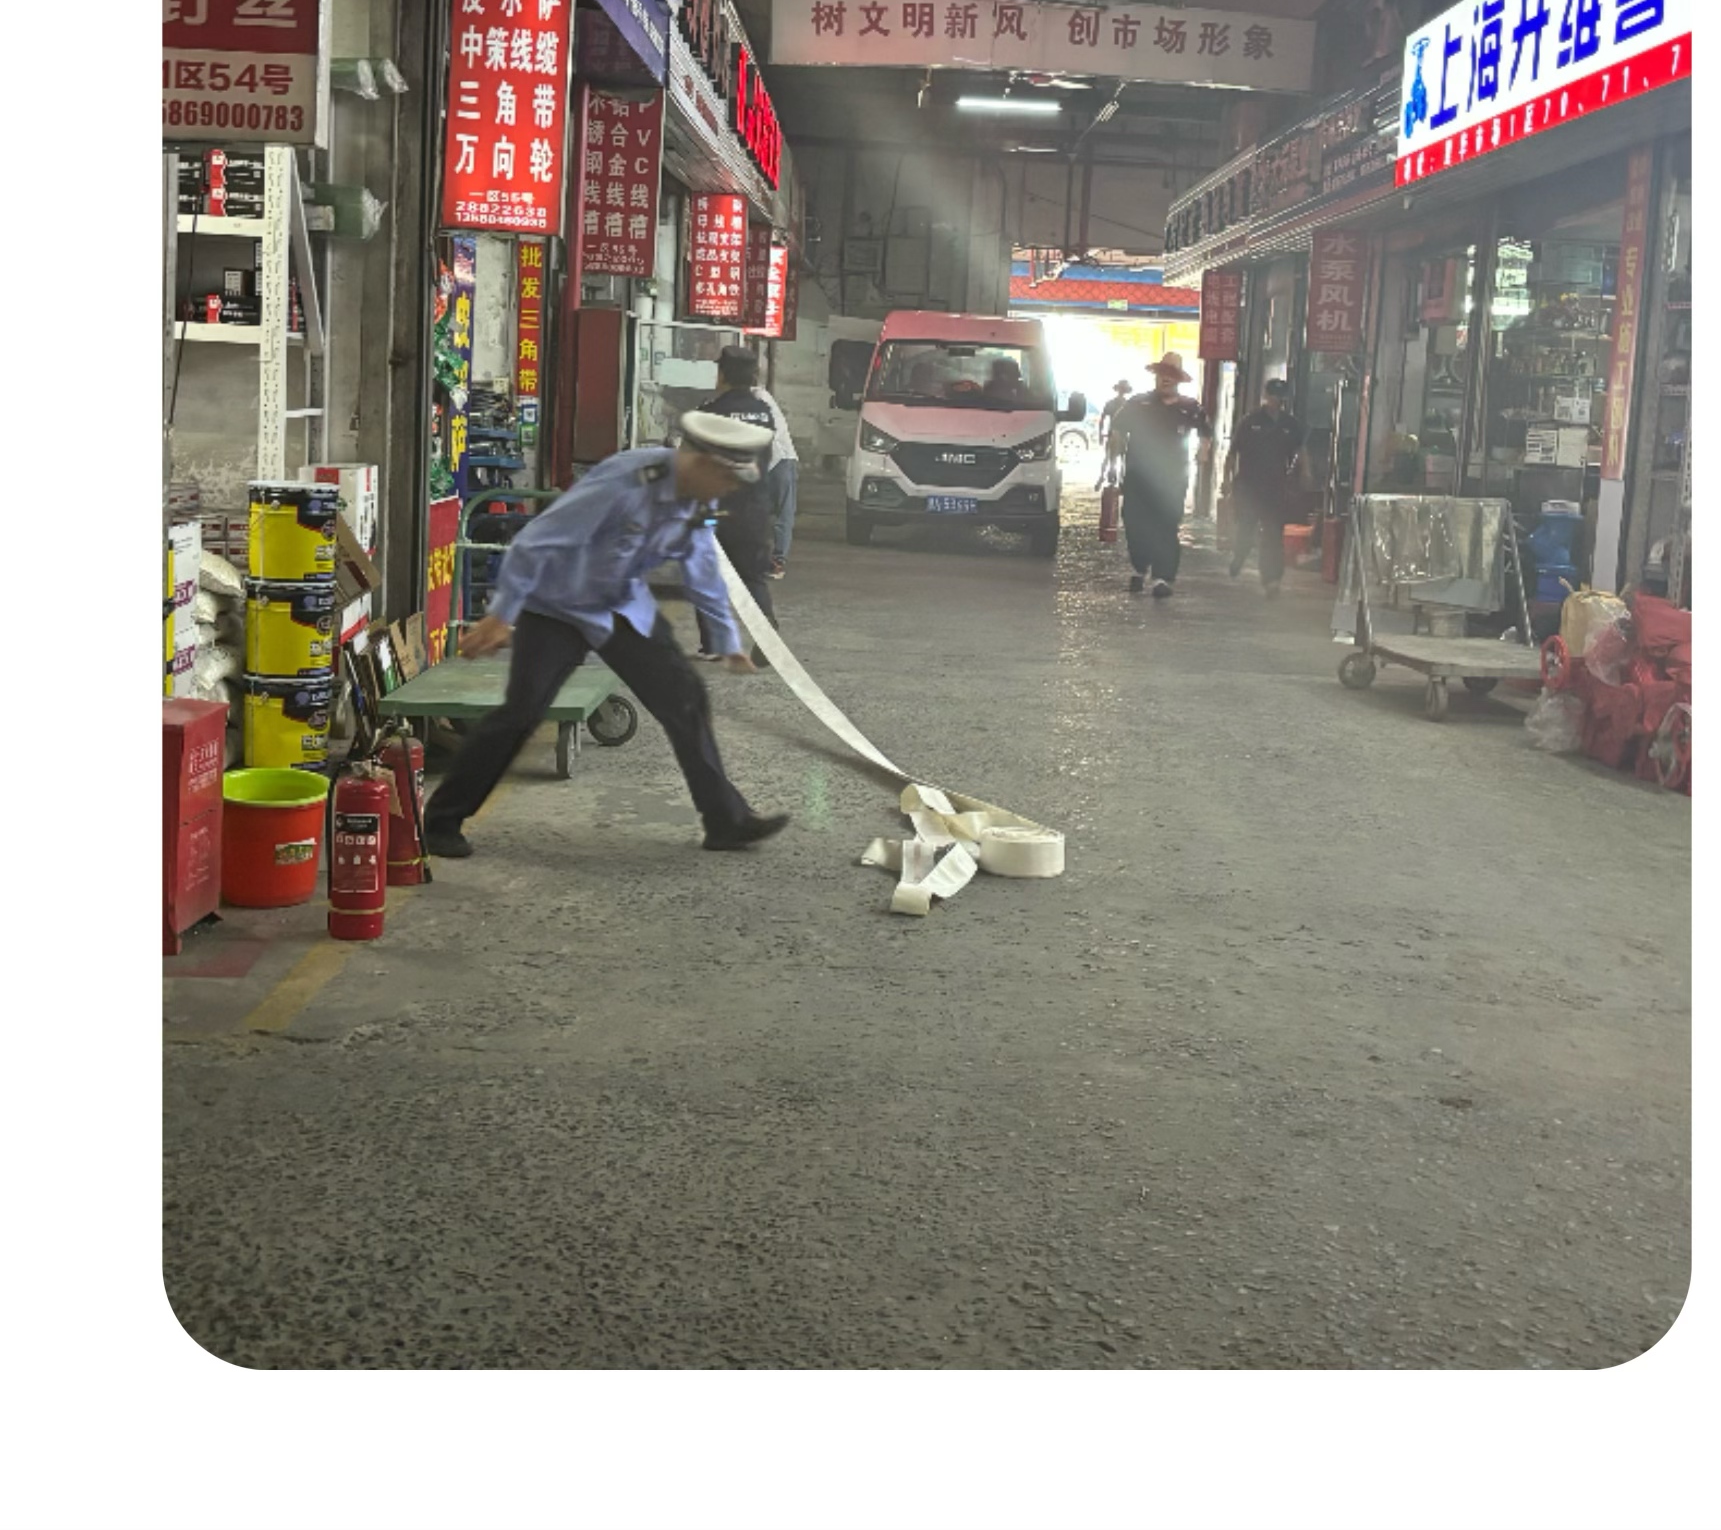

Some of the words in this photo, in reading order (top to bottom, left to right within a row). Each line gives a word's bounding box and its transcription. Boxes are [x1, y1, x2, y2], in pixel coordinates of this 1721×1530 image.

[810, 0, 1028, 41] 树文明新风
[1066, 8, 1275, 60] 创市场形象
[456, 78, 557, 129] 三角带
[453, 132, 555, 184] 万向轮
[517, 244, 543, 392] 批发三角带
